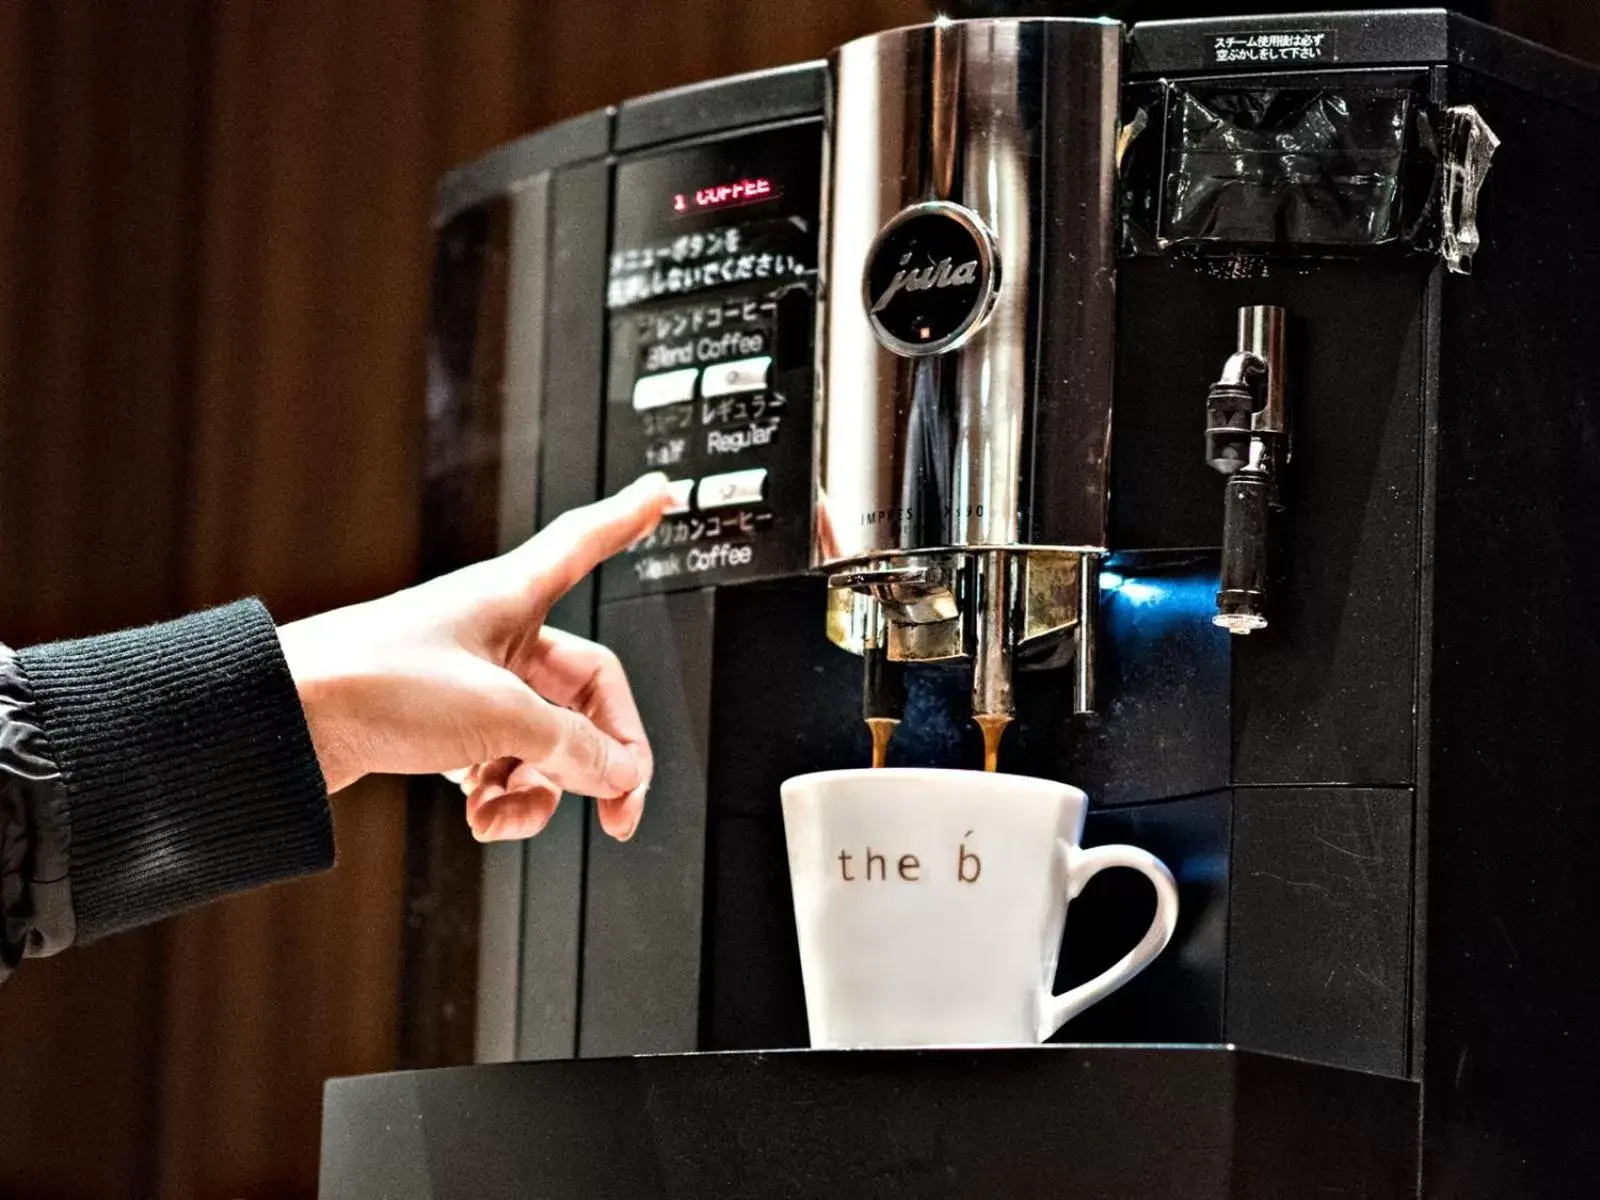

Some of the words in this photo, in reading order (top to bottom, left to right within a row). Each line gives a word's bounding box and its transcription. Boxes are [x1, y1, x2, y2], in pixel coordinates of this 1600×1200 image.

[1216, 48, 1321, 61] 空ぶかしをして下さい
[870, 252, 979, 315] jura
[697, 332, 762, 360] Coffee
[707, 421, 778, 453] Regular
[686, 542, 752, 572] Coffee
[838, 847, 920, 881] the
